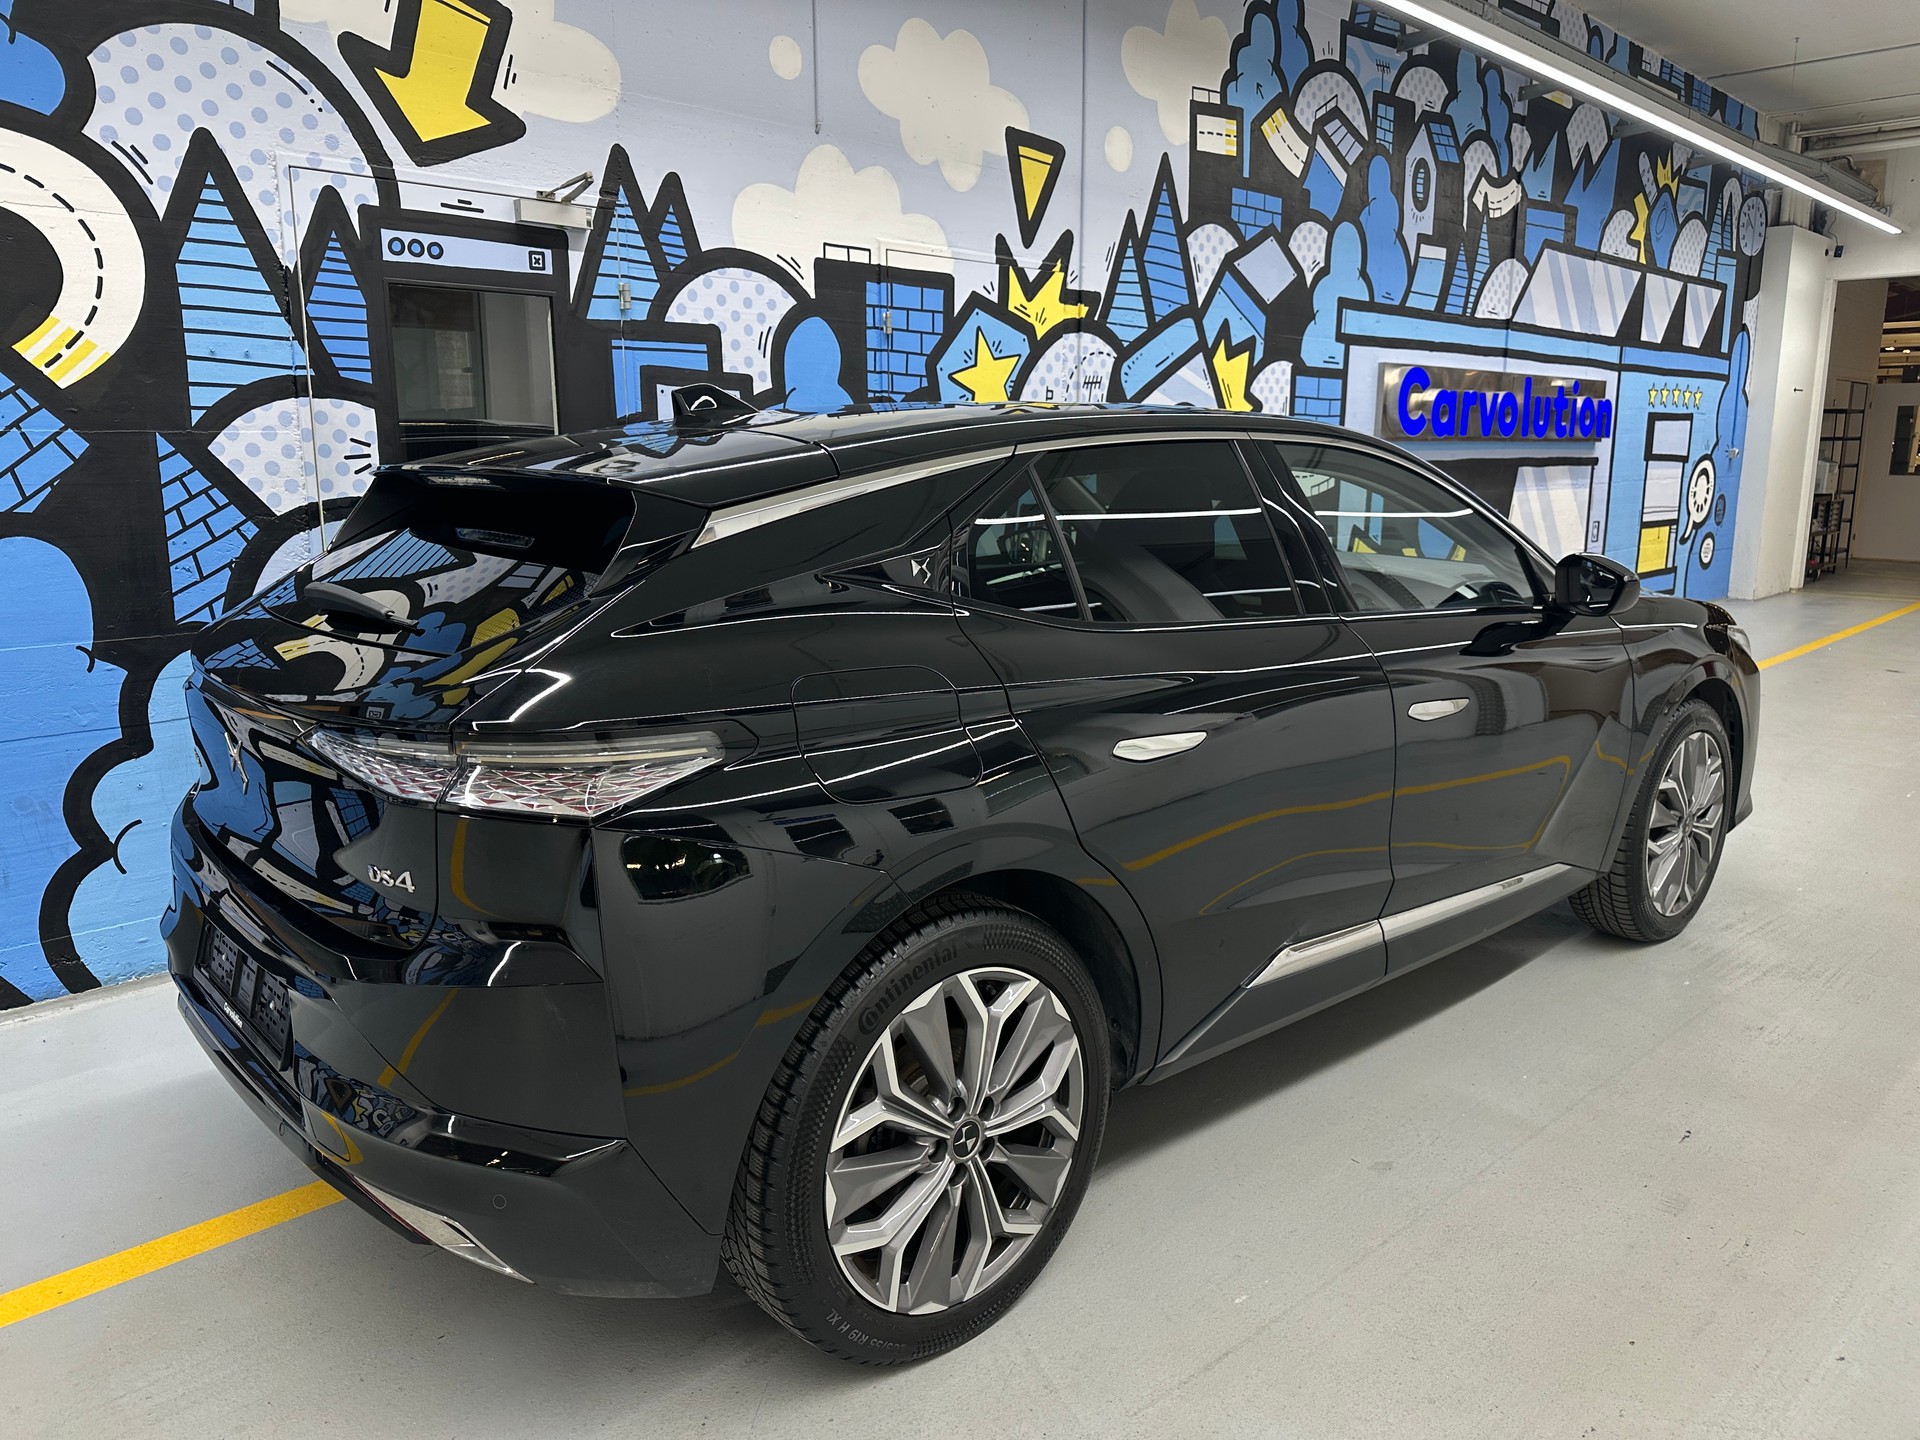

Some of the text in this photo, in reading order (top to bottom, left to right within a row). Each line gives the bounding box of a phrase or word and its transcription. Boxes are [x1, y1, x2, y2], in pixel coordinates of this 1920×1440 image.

[1398, 366, 1613, 439] Carvolution
[857, 943, 958, 1035] Continental
[825, 1308, 842, 1326] XL
[837, 1321, 851, 1334] H
[848, 1329, 869, 1345] R19
